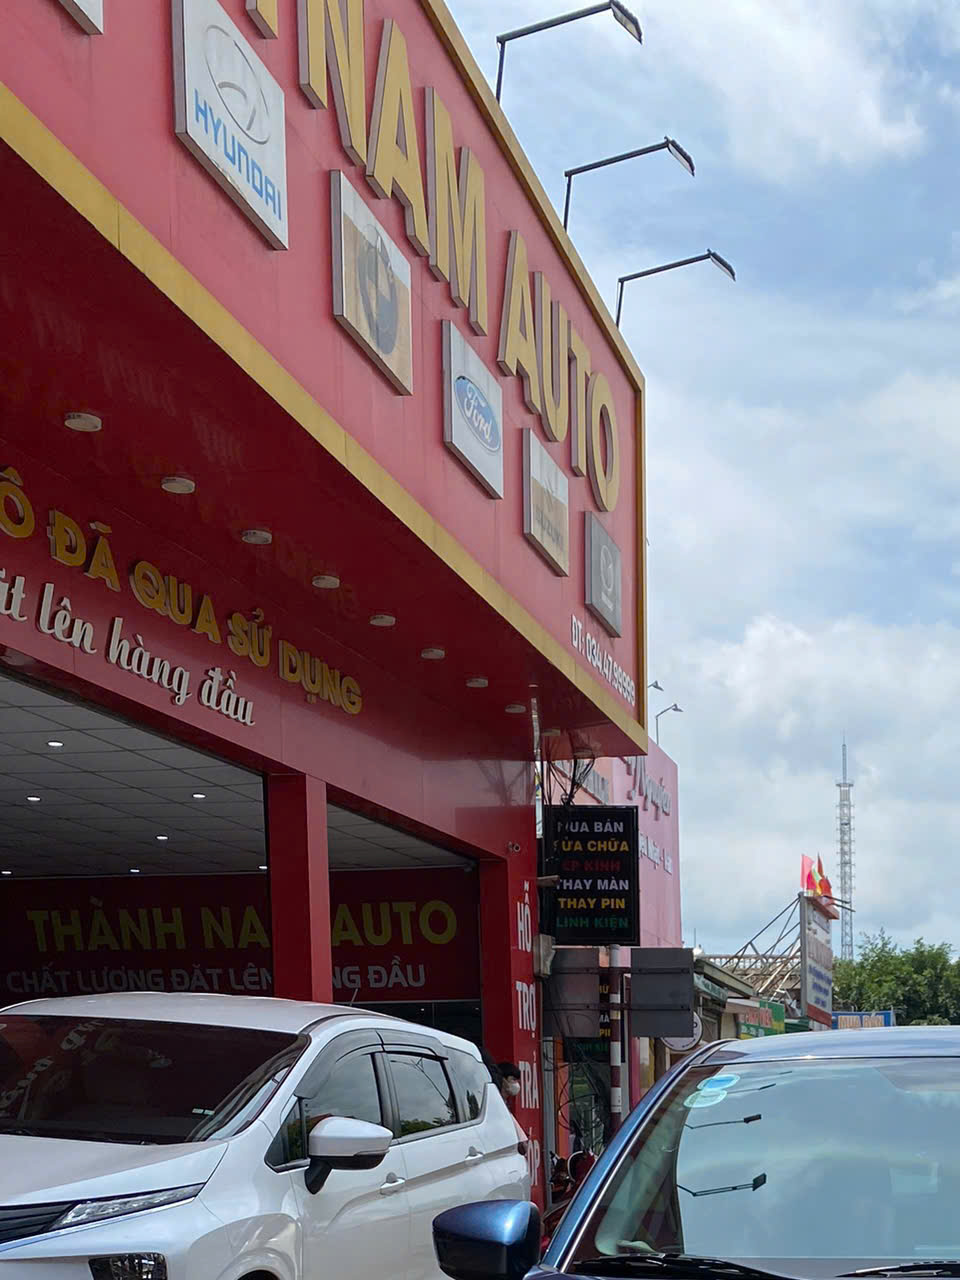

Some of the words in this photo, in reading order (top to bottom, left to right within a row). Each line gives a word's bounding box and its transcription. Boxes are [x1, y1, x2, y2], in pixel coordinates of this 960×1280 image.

[194, 88, 283, 221] HYUNDAI
[297, 0, 488, 337] NAM
[497, 229, 620, 512] AUTO
[463, 382, 492, 443] Ford
[47, 509, 121, 592] ĐÃ
[129, 561, 222, 644] QUA
[227, 608, 272, 668] SỬ
[278, 640, 363, 715] DỤNG
[36, 583, 97, 655] lên
[105, 617, 192, 706] hàng
[199, 667, 256, 726] đầu
[557, 822, 589, 833] UA
[594, 819, 624, 833] BÁN
[558, 898, 596, 909] THAY
[601, 898, 625, 909] PIN
[597, 876, 629, 890] MÀN
[27, 895, 187, 953] THÀNH
[202, 906, 271, 950] NA
[332, 900, 458, 945] AUTO
[367, 955, 426, 989] ĐẦU
